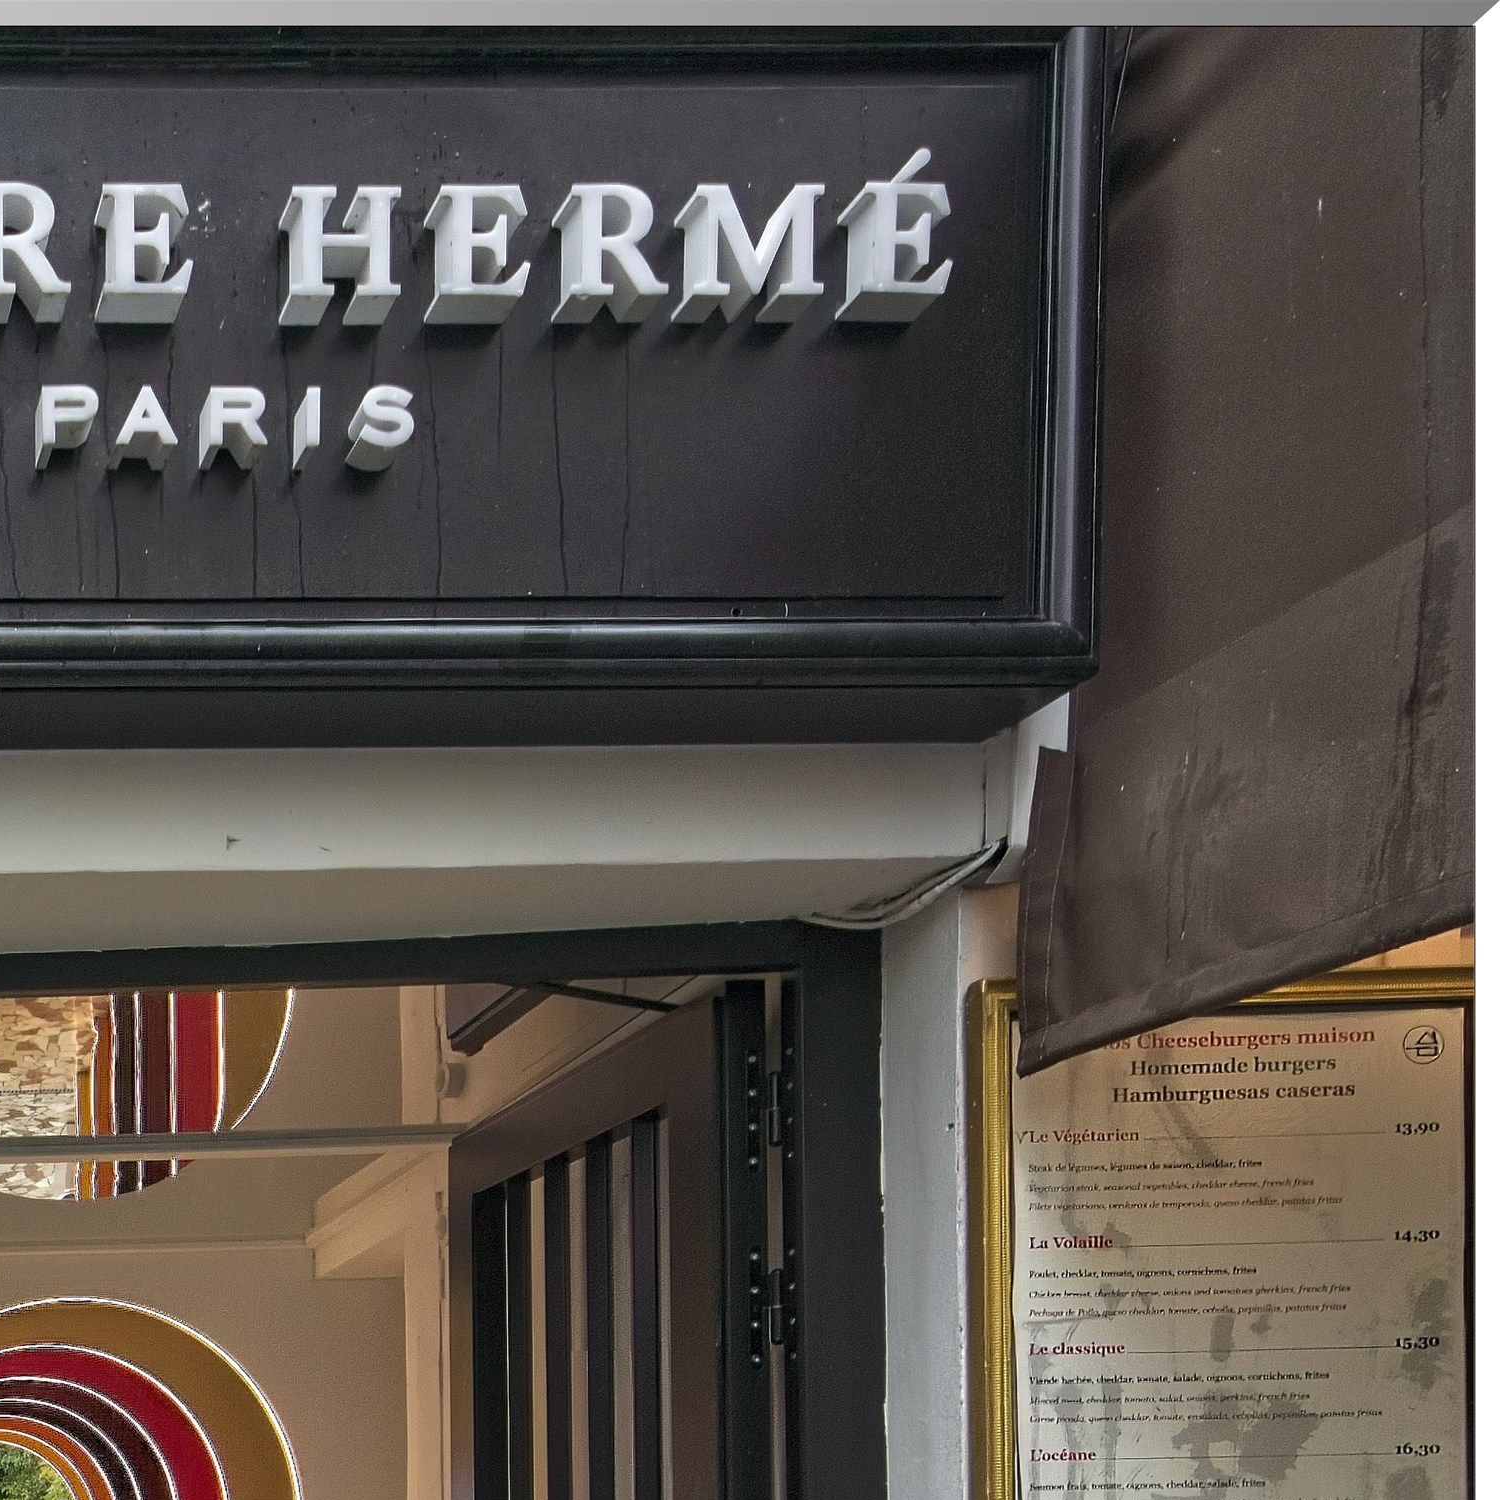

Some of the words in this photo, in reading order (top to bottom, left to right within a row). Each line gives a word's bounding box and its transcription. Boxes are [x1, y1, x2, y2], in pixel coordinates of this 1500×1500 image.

[278, 149, 953, 325] HERMÉ
[35, 383, 414, 473] PARIS
[1137, 1029, 1292, 1052] Cheeseburgers
[1298, 1028, 1375, 1045] maison
[1130, 1057, 1248, 1077] Homemade
[1254, 1056, 1336, 1076] burgers
[1112, 1085, 1270, 1103] Hamburguesas
[1276, 1082, 1355, 1099] caseras
[1027, 1129, 1049, 1143] Le
[1053, 1127, 1140, 1145] Végétarien
[1395, 1121, 1440, 1136] 13,90
[1029, 1236, 1049, 1250] La
[1053, 1235, 1113, 1250] Volaille
[1394, 1228, 1440, 1243] 14,30
[1029, 1342, 1049, 1356] Le
[1053, 1341, 1126, 1357] classique
[1395, 1336, 1440, 1351] 15,30
[1030, 1447, 1096, 1463] L'océane
[1395, 1442, 1440, 1456] 16,30
